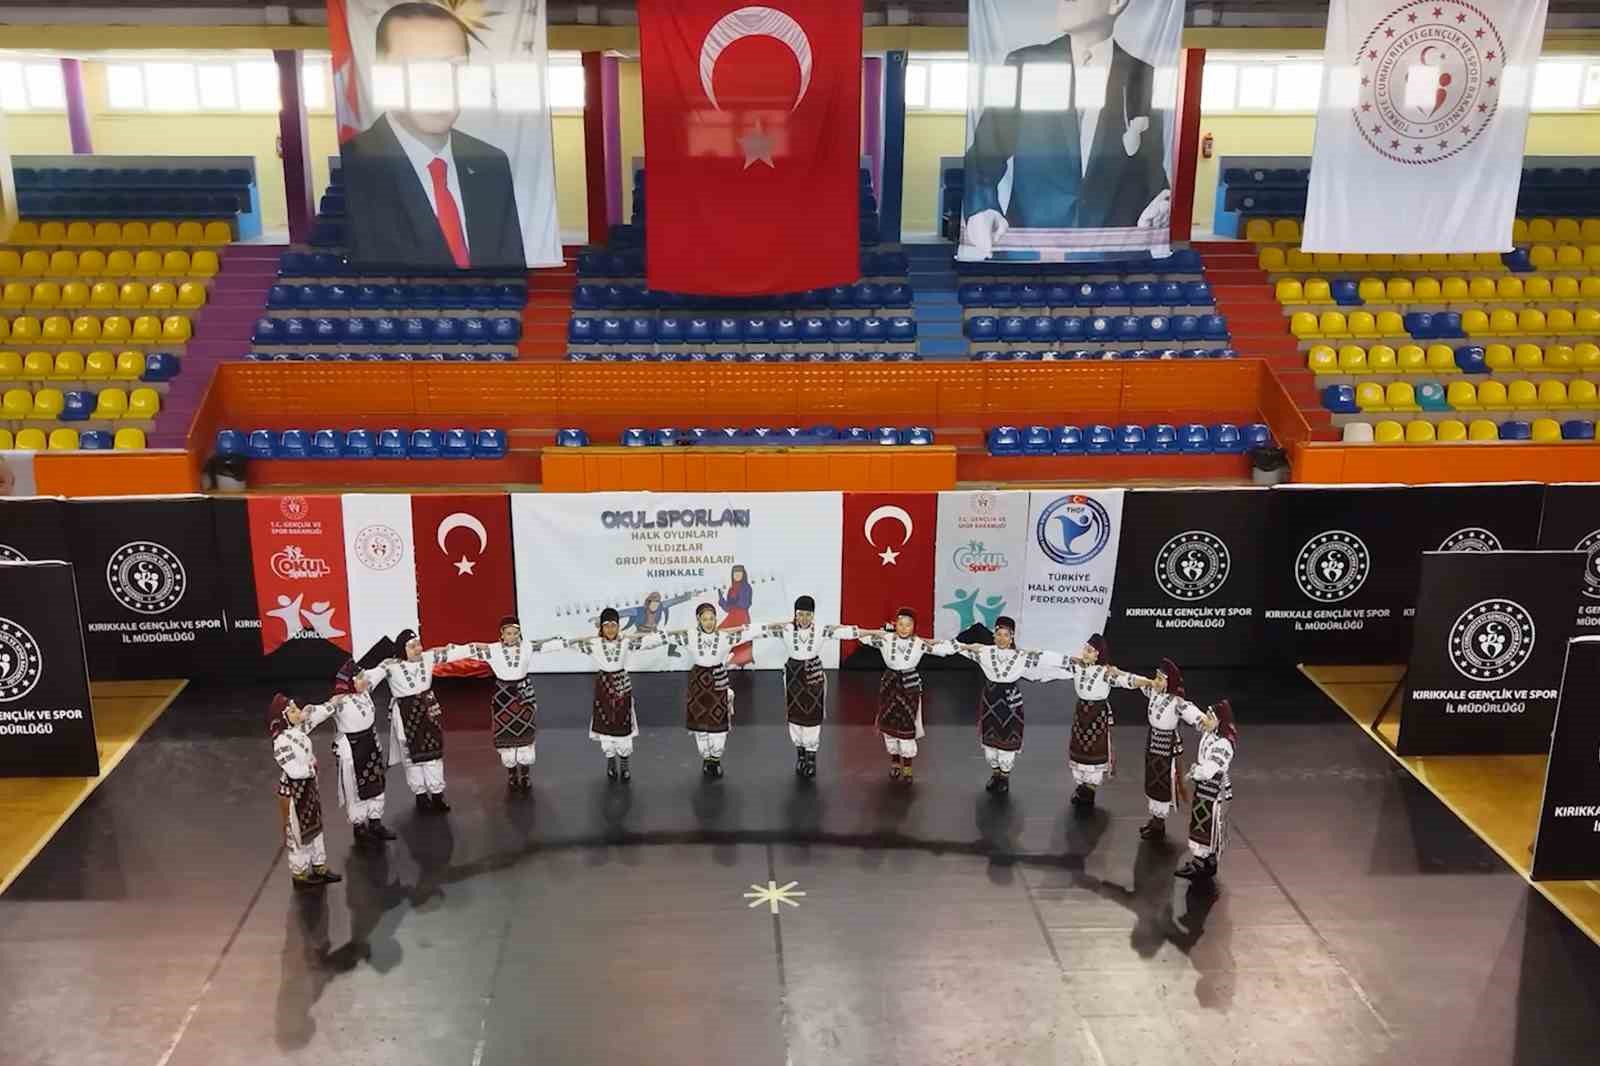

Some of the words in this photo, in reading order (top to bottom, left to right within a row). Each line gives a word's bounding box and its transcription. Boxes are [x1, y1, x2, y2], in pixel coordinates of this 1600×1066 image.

[1420, 28, 1461, 44] GENÇLİK
[1461, 41, 1473, 55] VE
[1378, 33, 1418, 96] CUMHURİYETİ
[1468, 55, 1478, 83] SPOR
[1378, 97, 1409, 132] TÜRKİYE
[1434, 86, 1476, 131] BAKANLIĞI
[601, 510, 655, 529] OKUL
[656, 508, 751, 528] SPORLARI
[631, 531, 661, 541] HALK
[663, 529, 719, 540] OYUNLARI
[648, 543, 704, 552] YILDIZLAR
[615, 556, 647, 566] GRUP
[647, 567, 705, 578] KIRIKKALE
[1048, 572, 1091, 582] TÜRKİYE
[1028, 584, 1055, 593] HALK
[1057, 585, 1108, 595] OYUNLARI
[1030, 595, 1104, 605] FEDERASYONU
[1126, 608, 1173, 617] KIRIKKALE
[1174, 606, 1214, 618] GENÇLİK
[1214, 608, 1226, 616] VE
[1227, 607, 1253, 616] SPOR
[1265, 609, 1312, 619] KIRIKKALE
[1313, 607, 1355, 619] GENÇLİK
[1355, 609, 1366, 618] VE
[1366, 608, 1391, 617] SPOR
[88, 621, 137, 632] KIRIKKALE
[139, 620, 181, 631] GENÇLİK
[181, 620, 194, 629] VE
[195, 619, 221, 629] SPOR
[1155, 618, 1164, 628] İL
[1165, 617, 1225, 628] MÜDÜRLÜĞÜ
[1295, 620, 1304, 631] İL
[1304, 619, 1364, 630] MÜDÜRLÜĞÜ
[122, 633, 131, 643] İL
[133, 631, 195, 643] MÜDÜRLÜĞÜ
[1412, 689, 1467, 700] KIRIKKALE
[1468, 687, 1513, 702] GENÇLİK
[1514, 690, 1528, 699] VE
[1529, 689, 1558, 699] SPOR
[1446, 702, 1455, 714] İL
[1457, 701, 1526, 714] MÜDÜRLÜĞÜ
[36, 710, 52, 720] VE
[53, 709, 82, 720] SPOR
